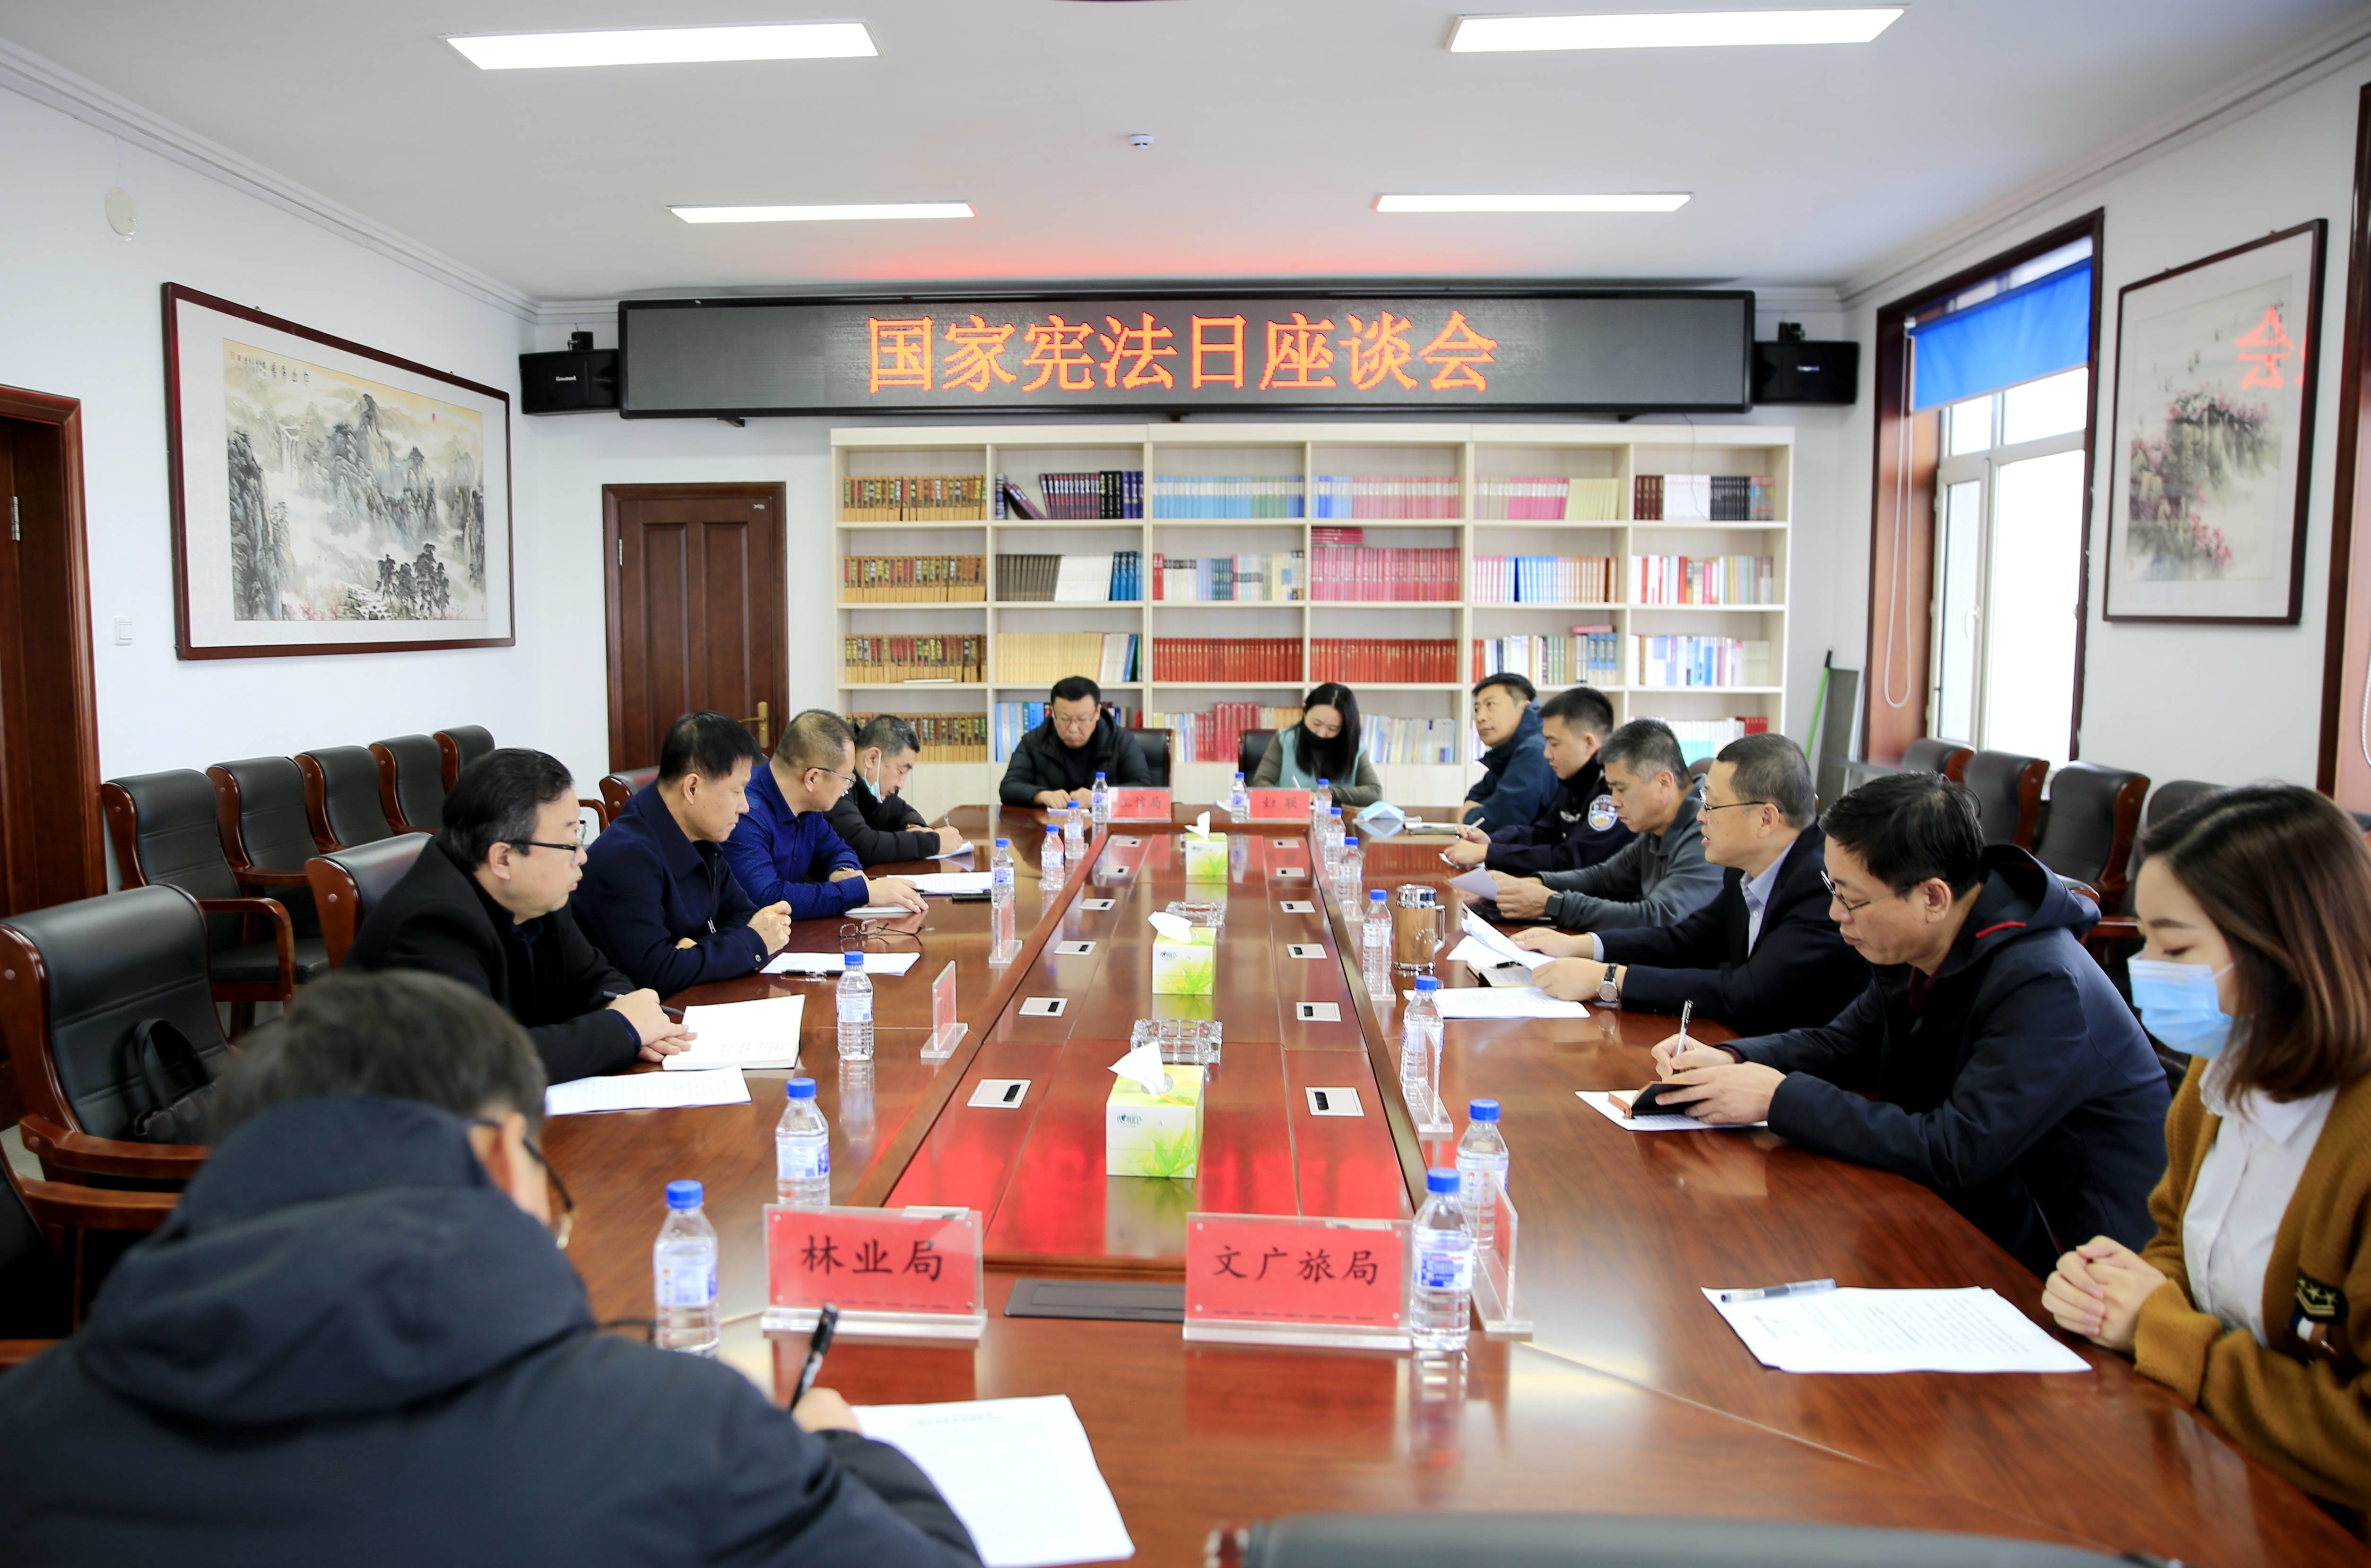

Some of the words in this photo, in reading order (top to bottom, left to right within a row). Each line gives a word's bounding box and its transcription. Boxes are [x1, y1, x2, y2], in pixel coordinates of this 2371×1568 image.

[868, 310, 1498, 393] 国家宪法日座谈会
[800, 1235, 943, 1282] 林业局
[1212, 1245, 1379, 1286] 文广旅局
